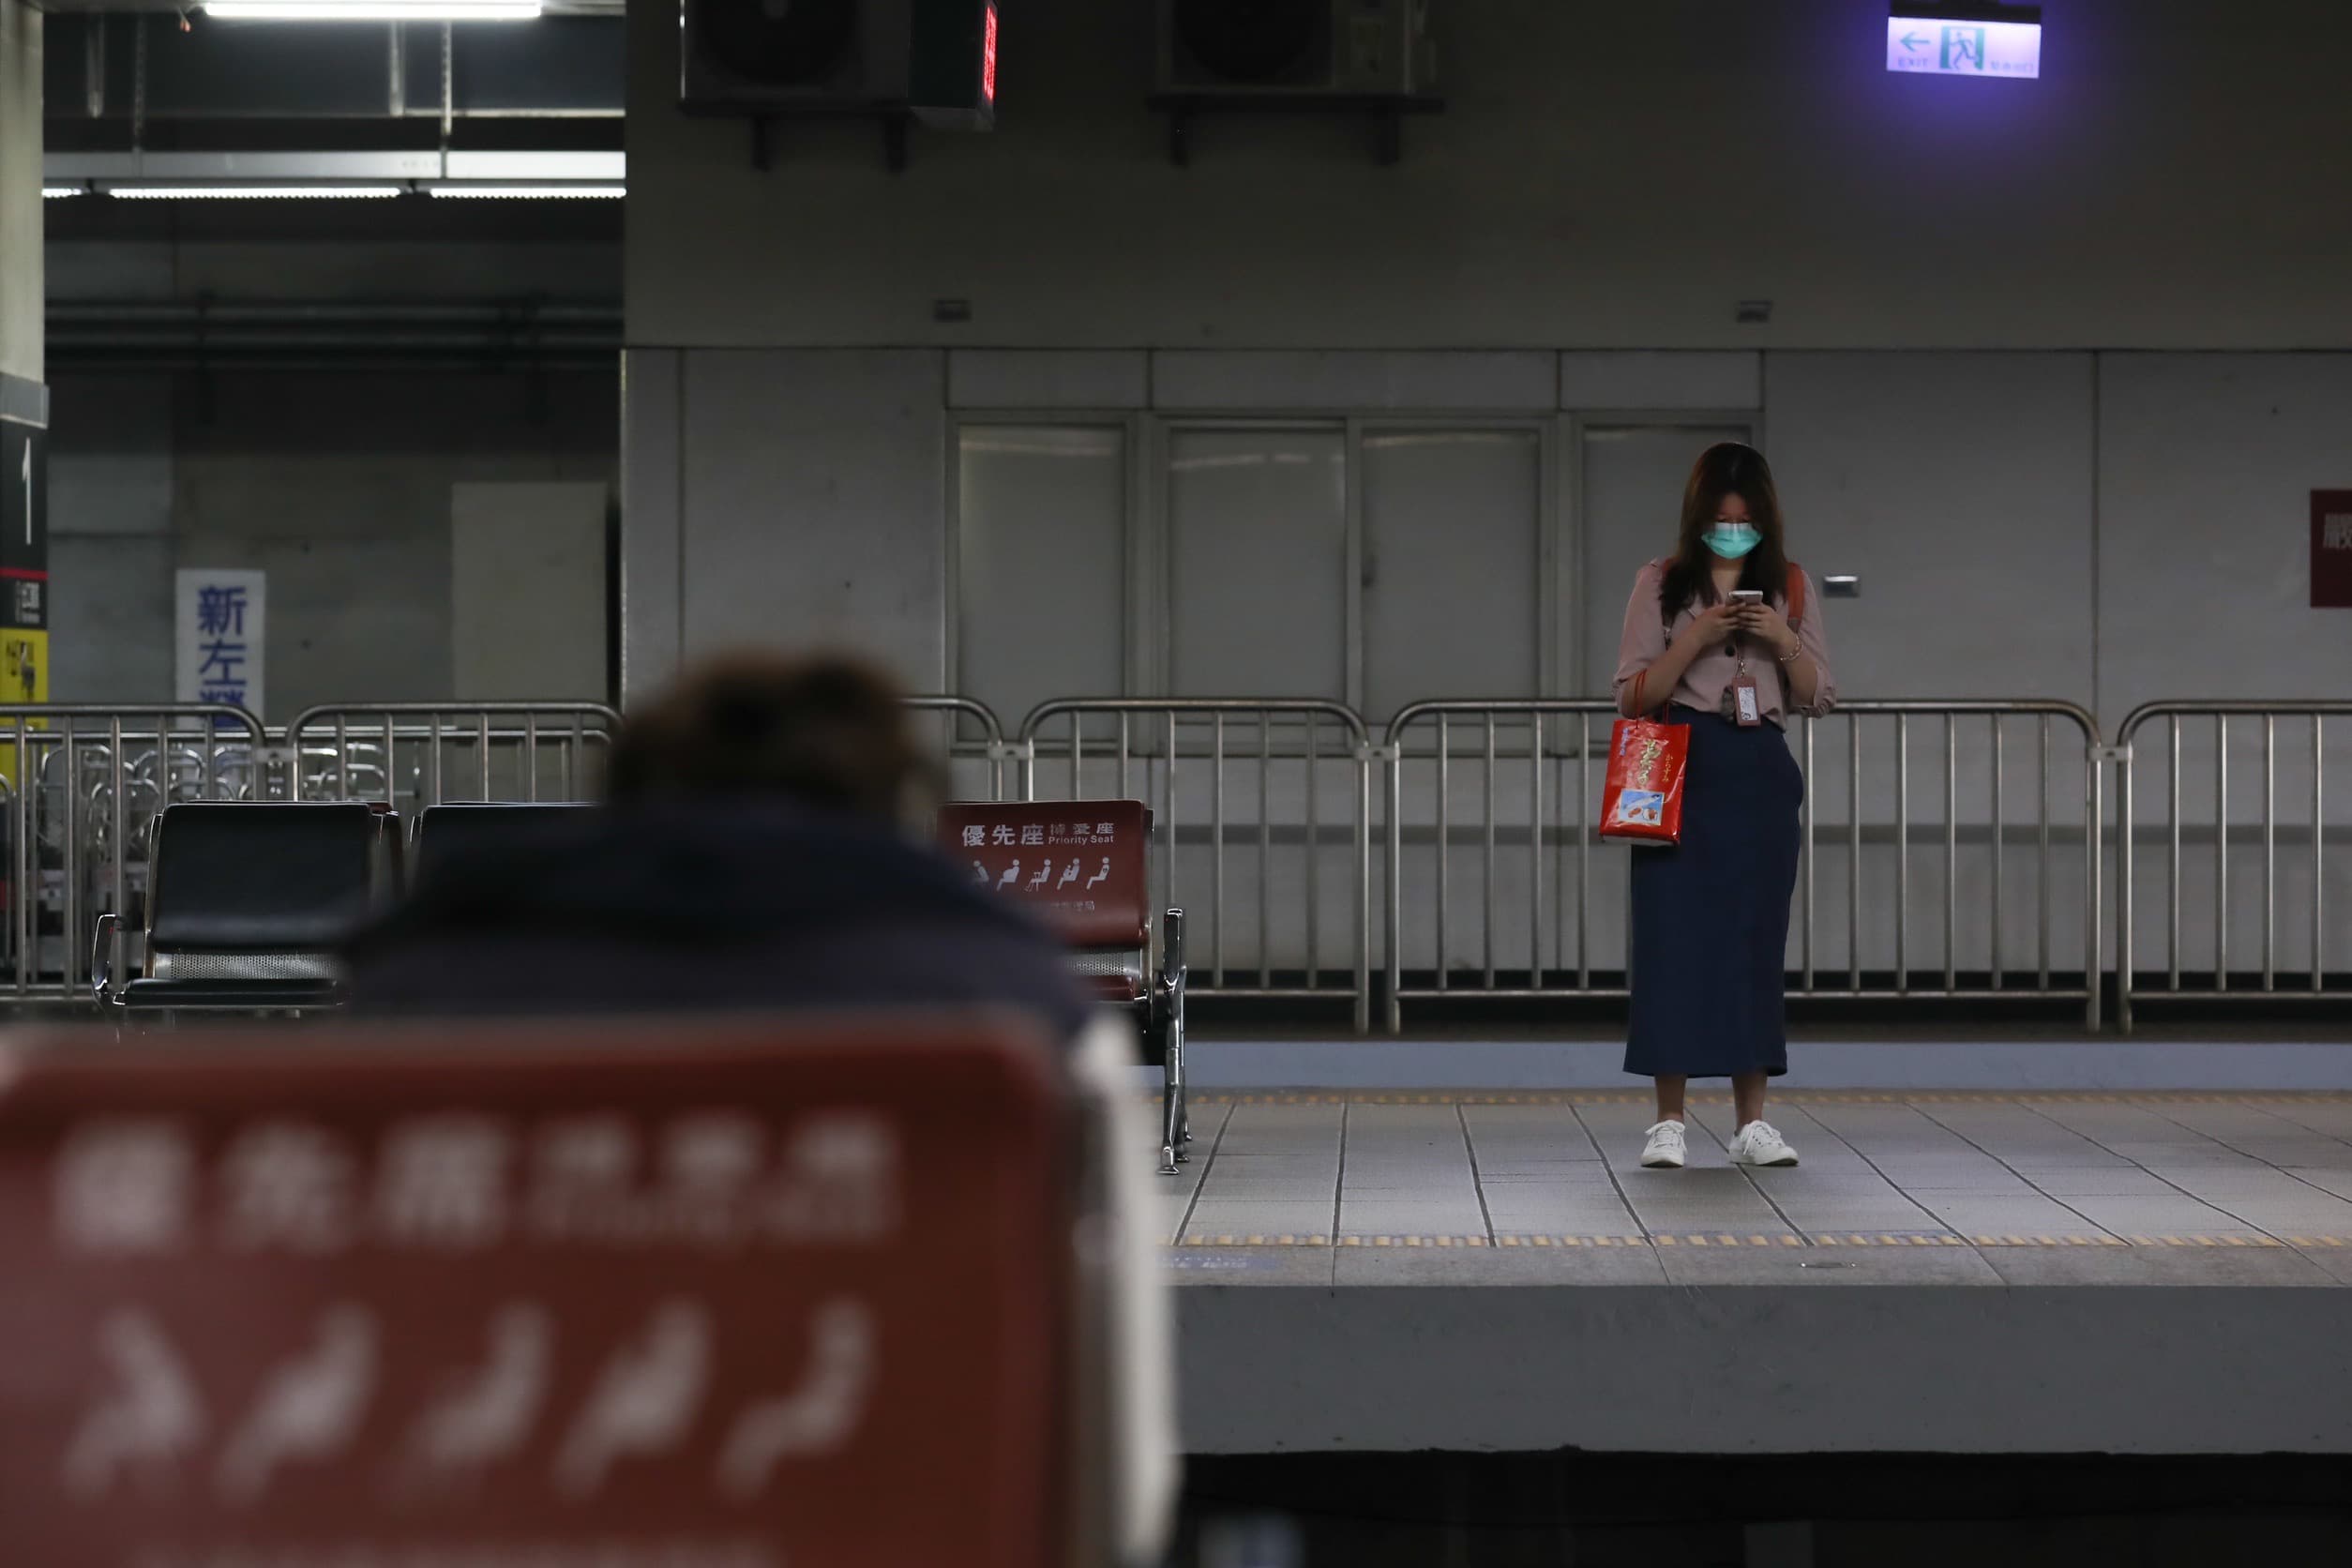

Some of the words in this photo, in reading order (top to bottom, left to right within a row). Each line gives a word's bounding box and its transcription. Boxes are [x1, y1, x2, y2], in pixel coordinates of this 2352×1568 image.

[961, 823, 1045, 847] 優先座
[1048, 835, 1088, 846] Priority
[1090, 834, 1114, 844] Seat
